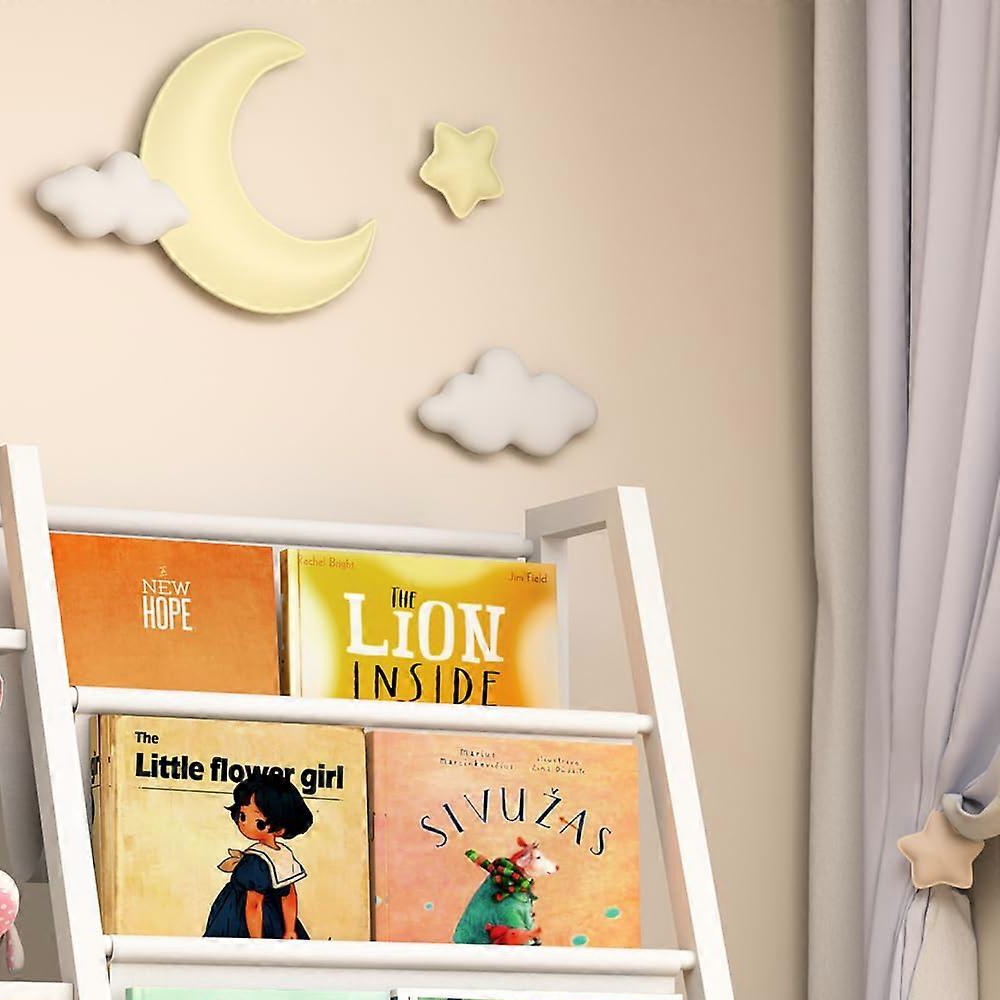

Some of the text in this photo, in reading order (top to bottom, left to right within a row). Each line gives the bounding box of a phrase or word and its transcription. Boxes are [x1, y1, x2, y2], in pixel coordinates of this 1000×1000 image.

[329, 557, 355, 570] Bright
[142, 578, 191, 596] NEW
[527, 572, 548, 584] Field
[391, 586, 417, 609] THE
[142, 595, 193, 631] HOPE
[353, 660, 501, 706] INSIDE
[135, 731, 159, 744] The
[135, 752, 205, 781] Little
[300, 763, 344, 795] girl
[420, 787, 612, 856] SIVUŽAS
